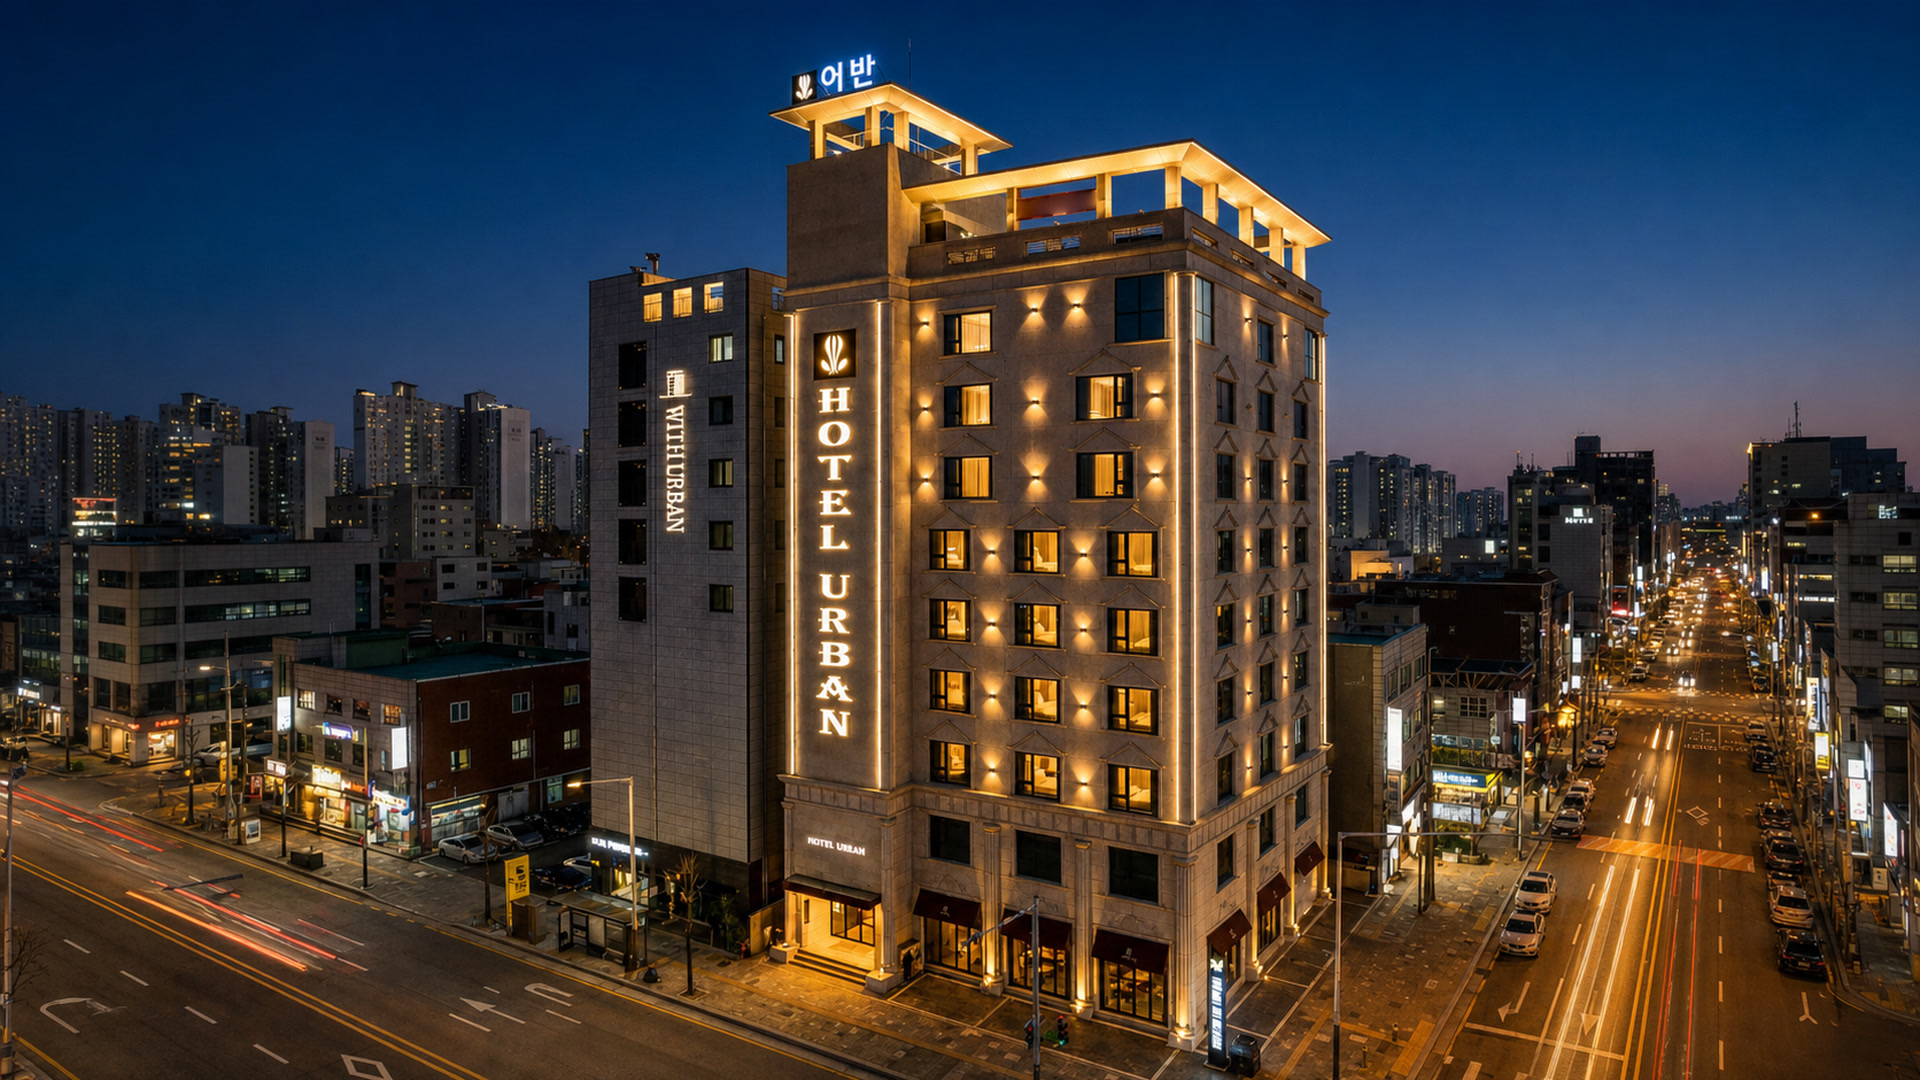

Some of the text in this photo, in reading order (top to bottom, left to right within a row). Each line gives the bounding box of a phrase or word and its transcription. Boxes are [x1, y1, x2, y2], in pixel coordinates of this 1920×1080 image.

[820, 53, 876, 92] 어반
[815, 387, 853, 737] HOTEL URBAN
